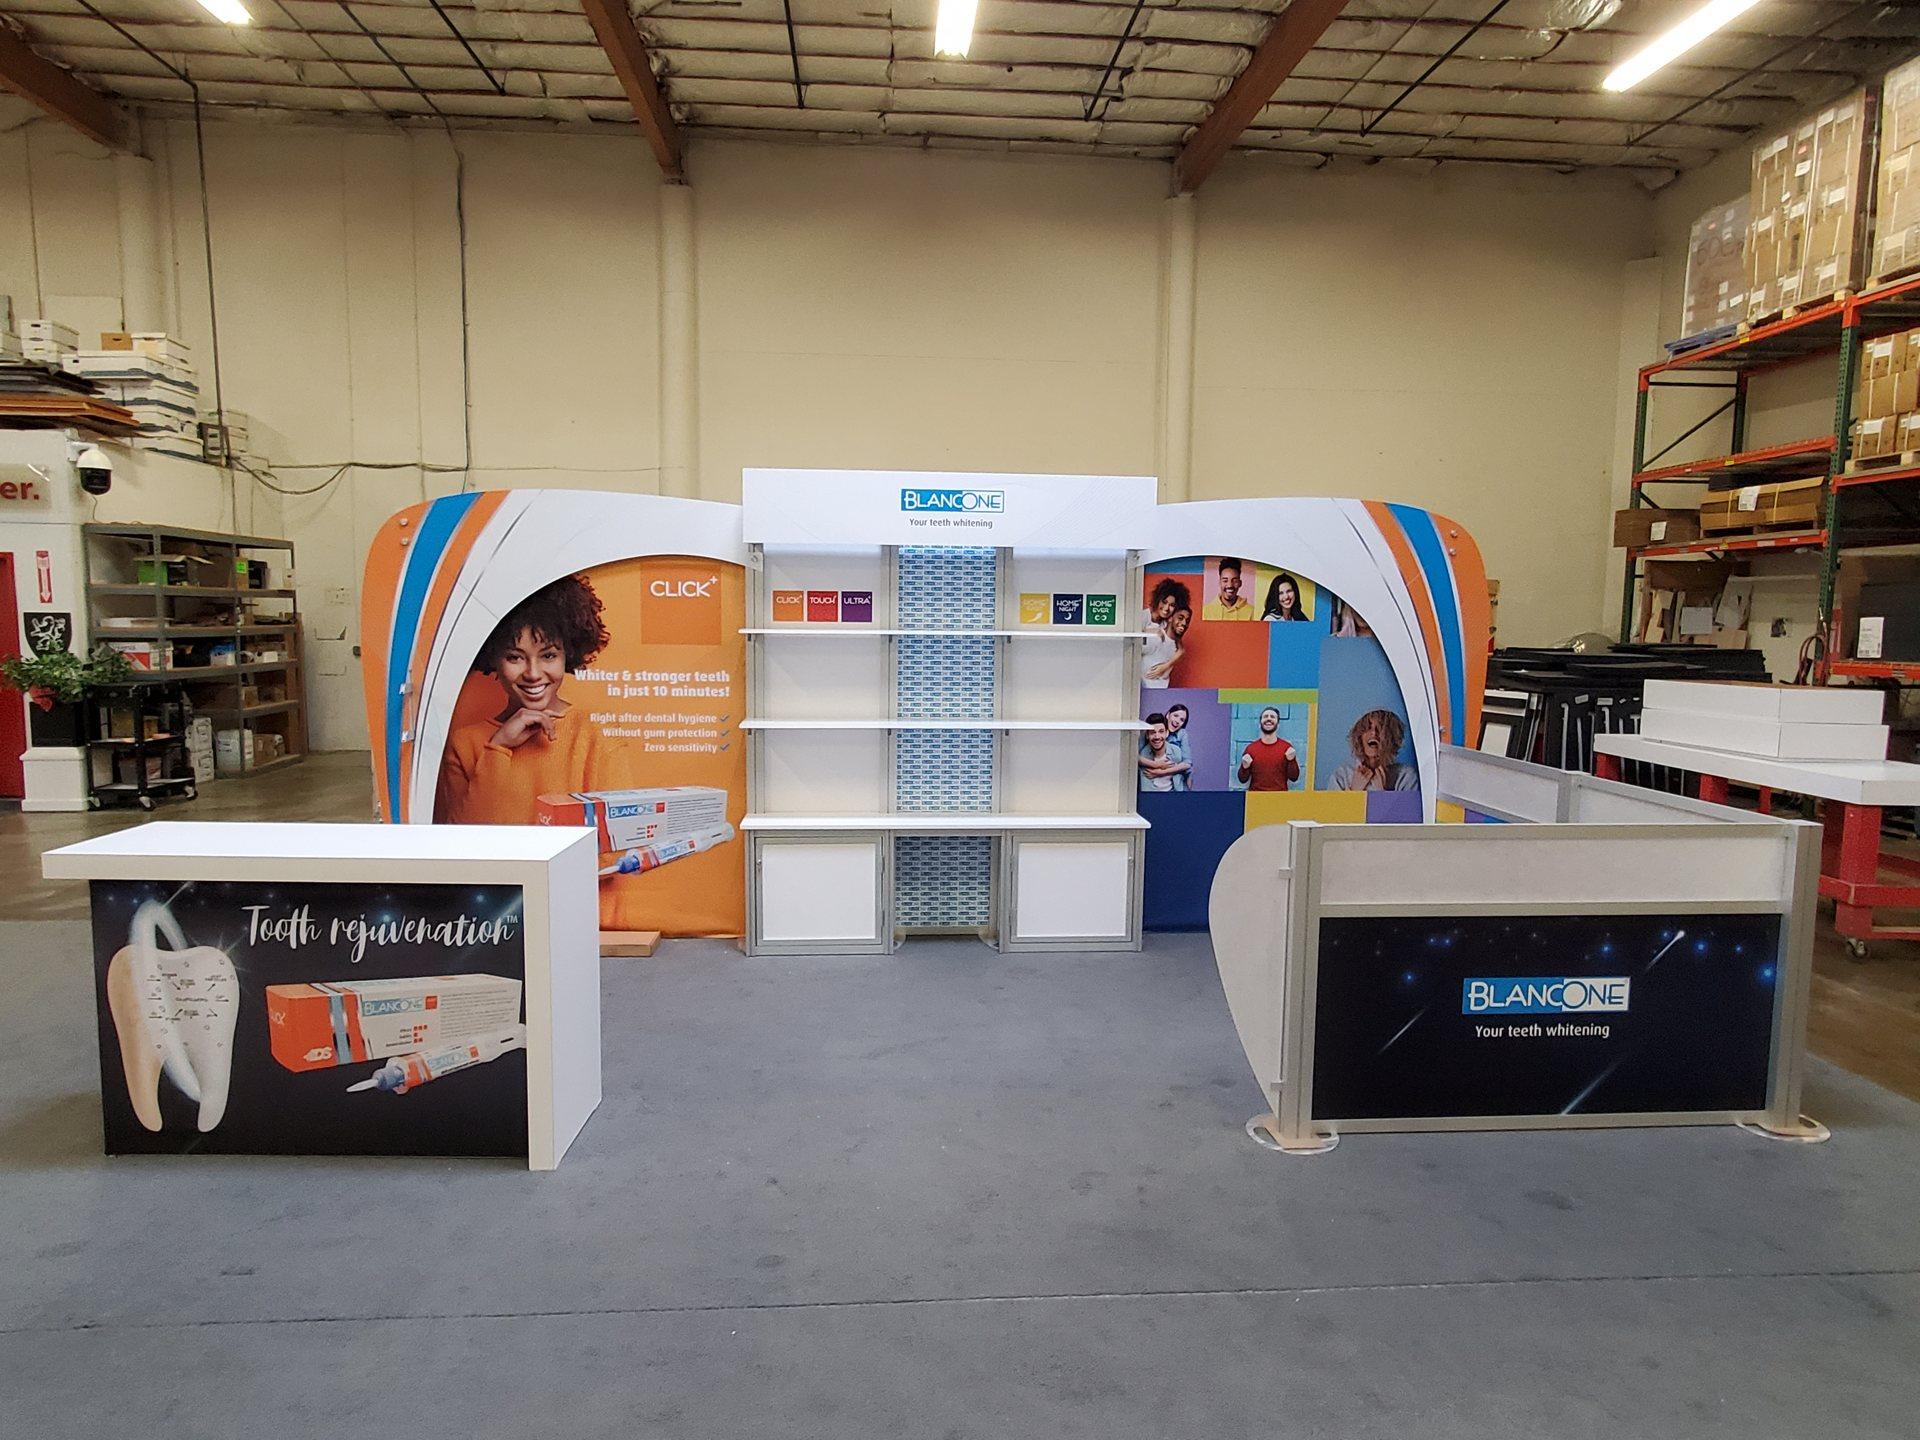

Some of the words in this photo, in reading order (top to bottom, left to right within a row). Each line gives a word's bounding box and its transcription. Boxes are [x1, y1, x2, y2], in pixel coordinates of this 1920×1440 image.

[903, 490, 1002, 510] BLANCONE
[909, 518, 927, 527] Your
[930, 518, 951, 527] teeth
[953, 518, 993, 529] whitening
[574, 668, 618, 681] Whiter
[622, 670, 631, 681] &
[635, 670, 691, 684] stronger
[694, 670, 730, 682] teeth
[607, 684, 620, 696] in
[623, 684, 649, 699] just
[652, 686, 668, 696] 10
[671, 685, 730, 697] minutes!
[590, 712, 616, 724] Right
[619, 712, 642, 723] after
[644, 713, 676, 723] dental
[678, 713, 717, 725] hygiene
[602, 728, 641, 737] Without
[643, 729, 666, 739] gum
[668, 728, 718, 739] protection
[644, 743, 665, 752] Zero
[668, 743, 718, 754] sensitivity
[241, 903, 322, 949] Tooth
[1467, 980, 1626, 1011] BLANCONE
[1475, 1025, 1504, 1038] Your
[1508, 1024, 1542, 1037] teeth
[1546, 1023, 1610, 1038] whitening
